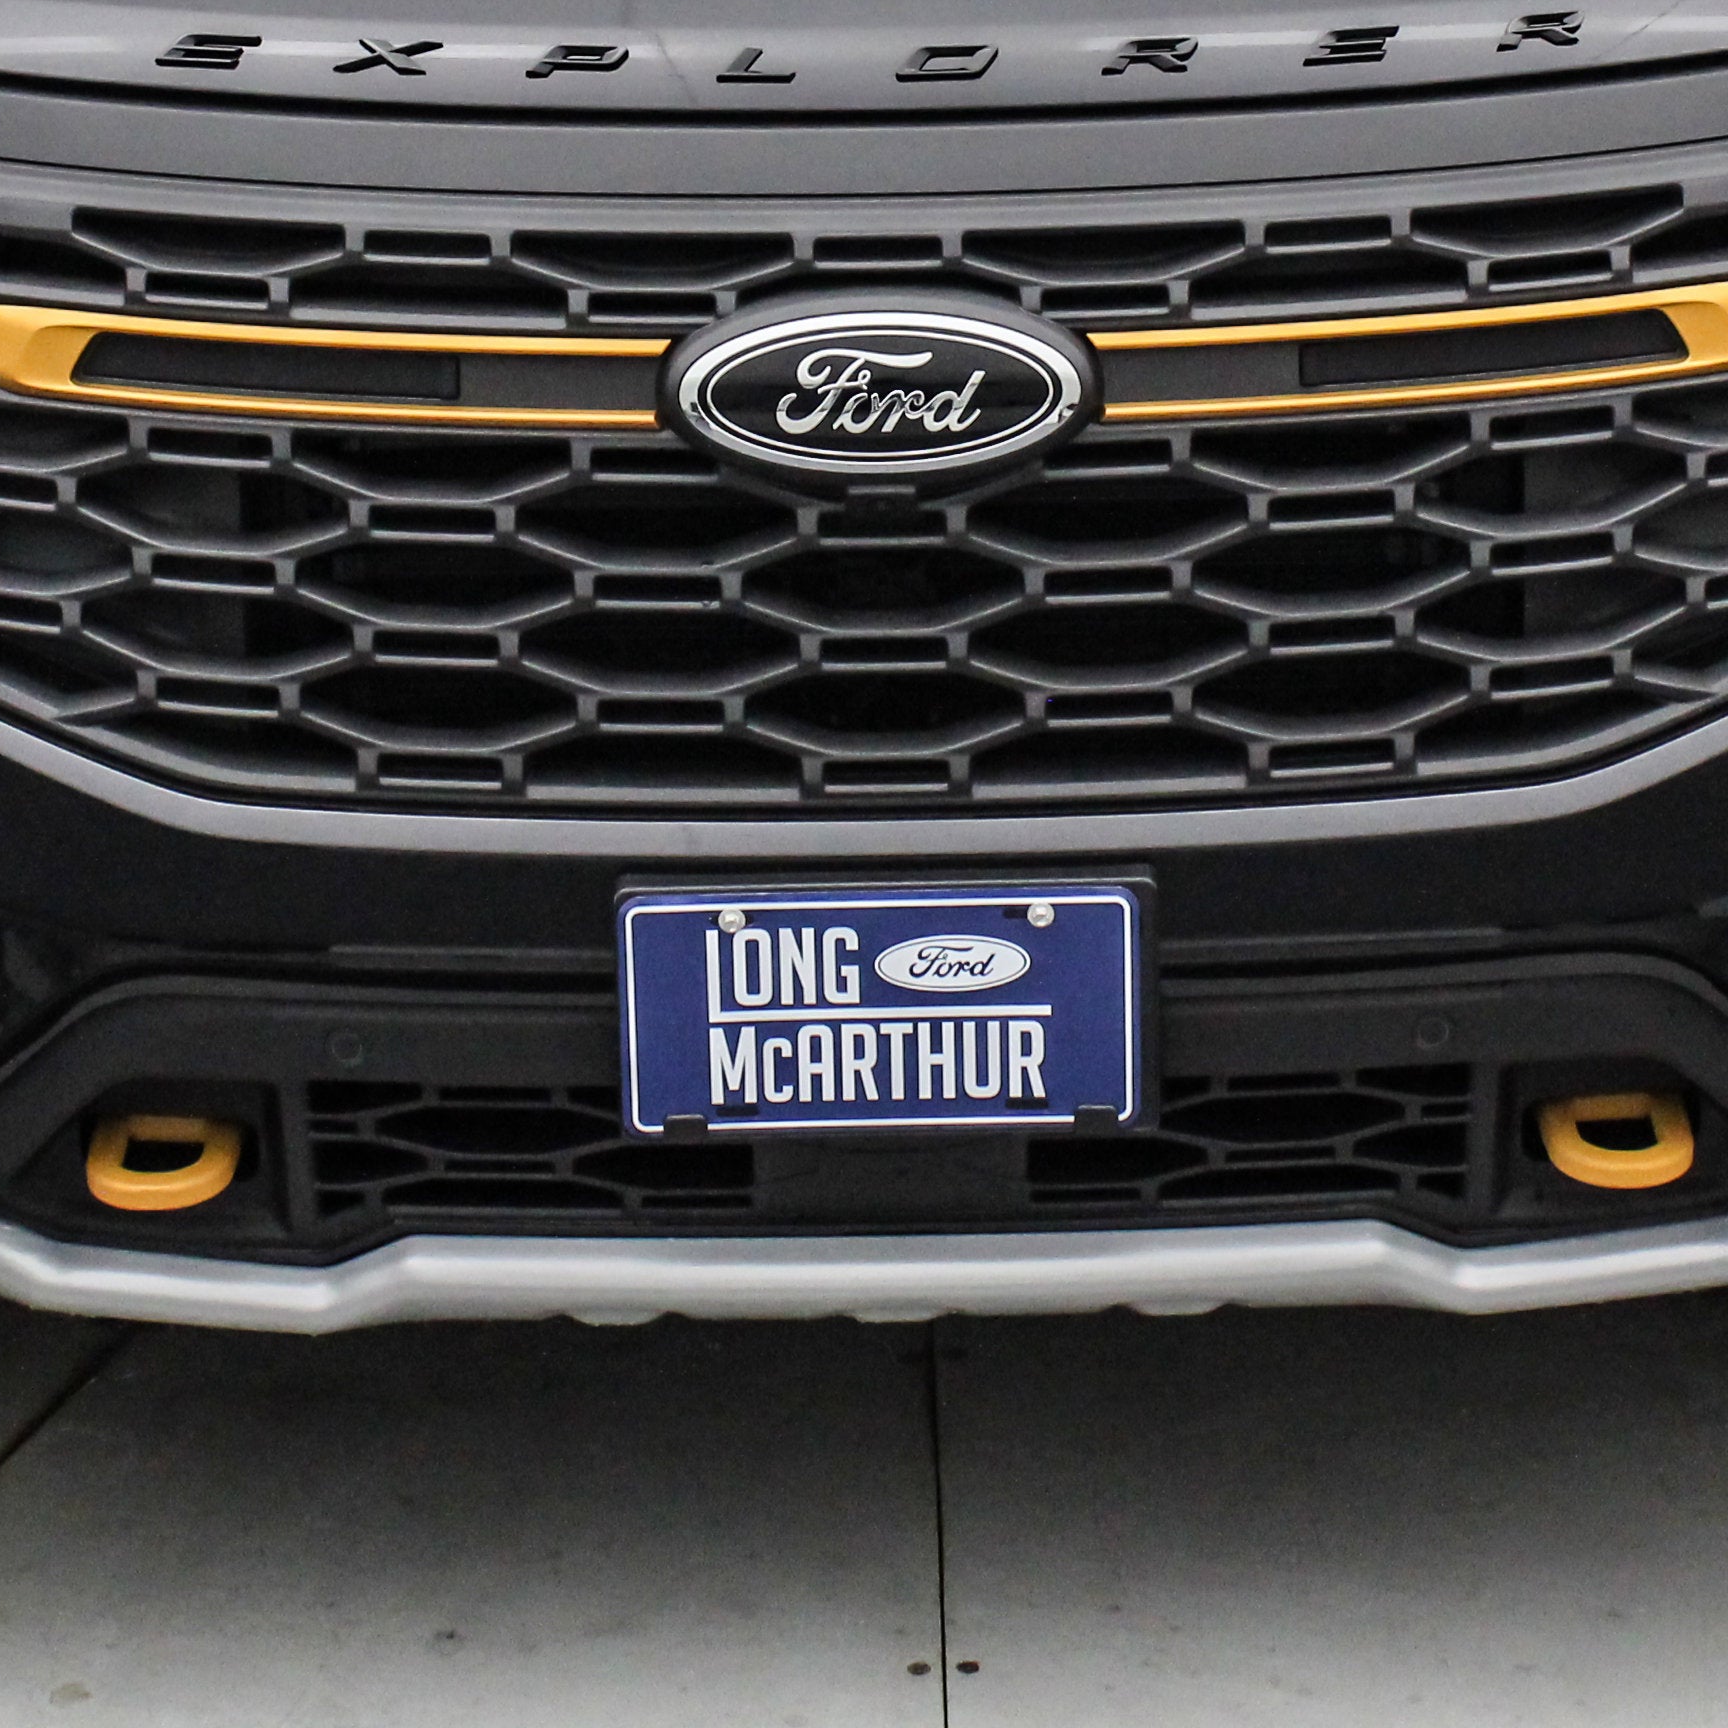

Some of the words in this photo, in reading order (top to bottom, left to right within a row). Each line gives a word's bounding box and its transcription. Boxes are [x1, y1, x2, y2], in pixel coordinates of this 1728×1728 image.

[155, 10, 1585, 84] EXPLORER
[775, 348, 987, 435] Ford
[705, 927, 861, 1022] LONG
[908, 945, 997, 979] Ford
[708, 1020, 1047, 1106] McARTHUR
